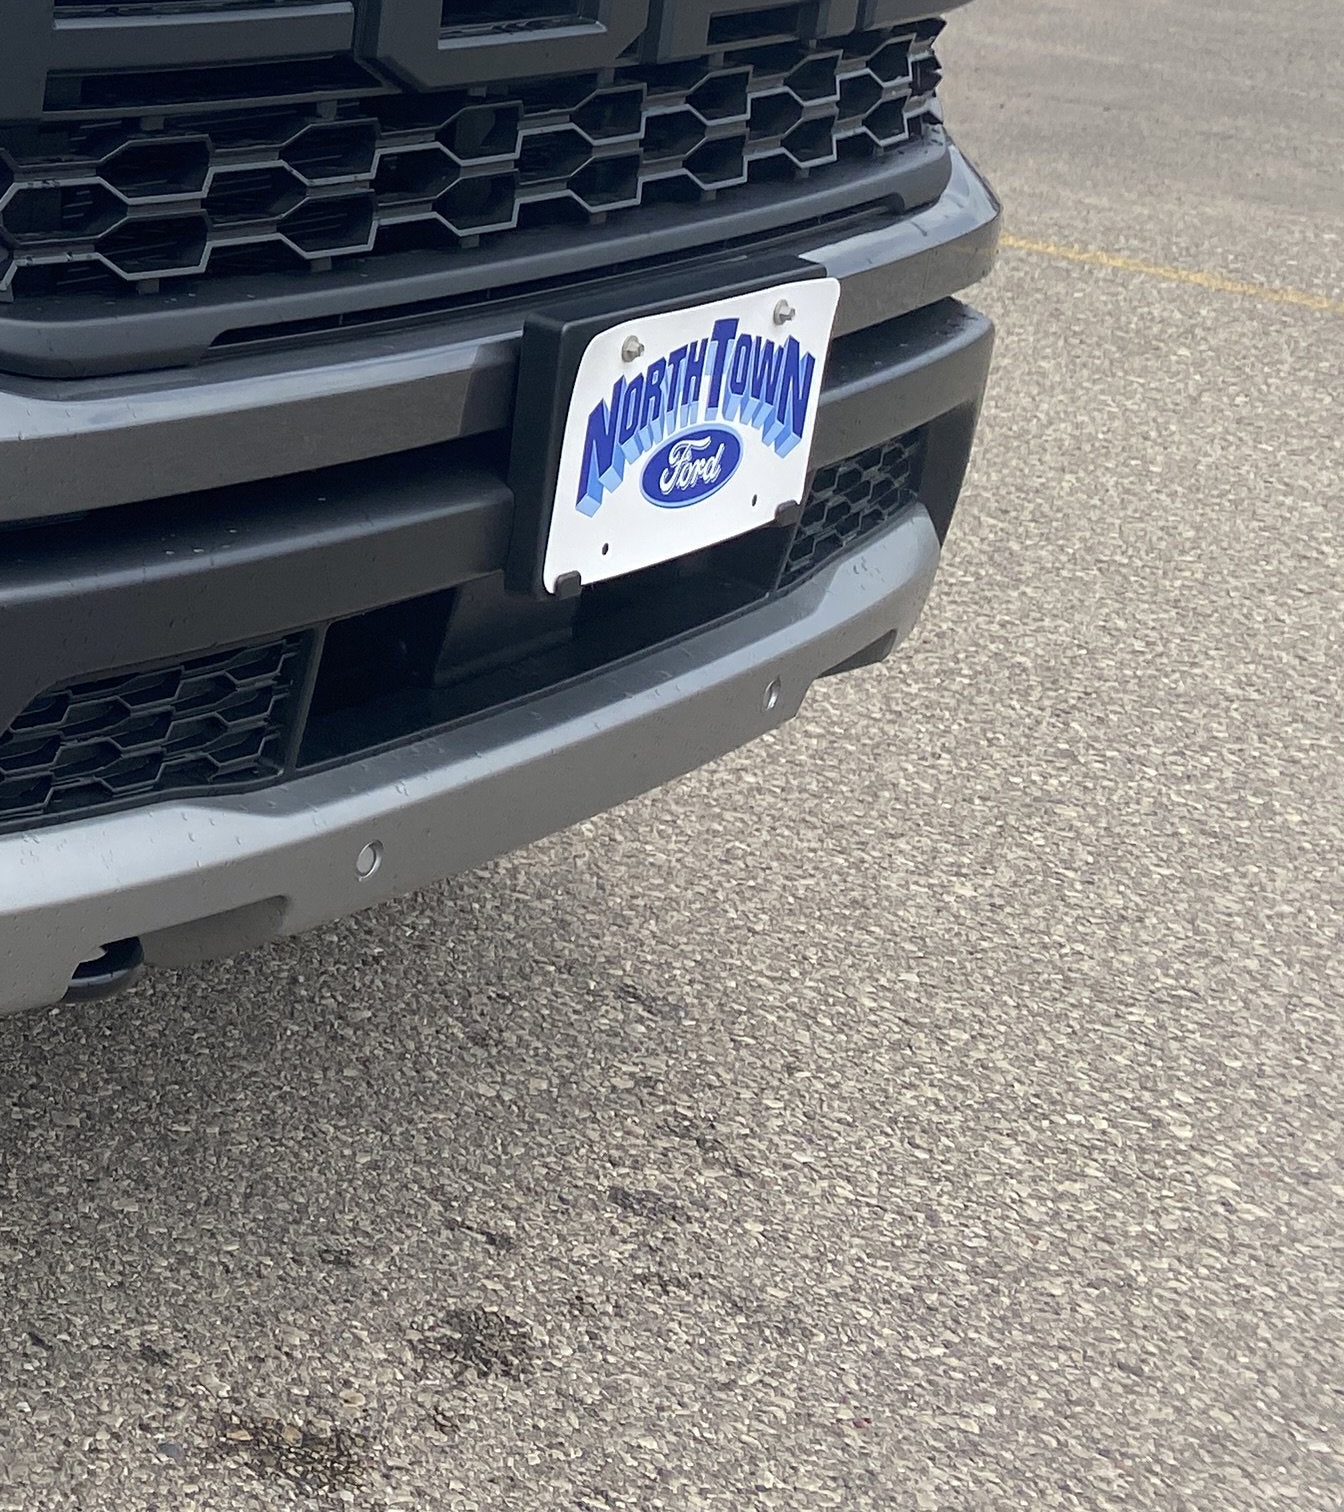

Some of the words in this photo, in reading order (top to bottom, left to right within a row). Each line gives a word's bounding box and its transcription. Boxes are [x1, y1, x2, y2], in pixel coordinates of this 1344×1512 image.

[575, 337, 709, 514] NORTH
[706, 318, 816, 454] TOWN
[659, 435, 726, 494] Ford
